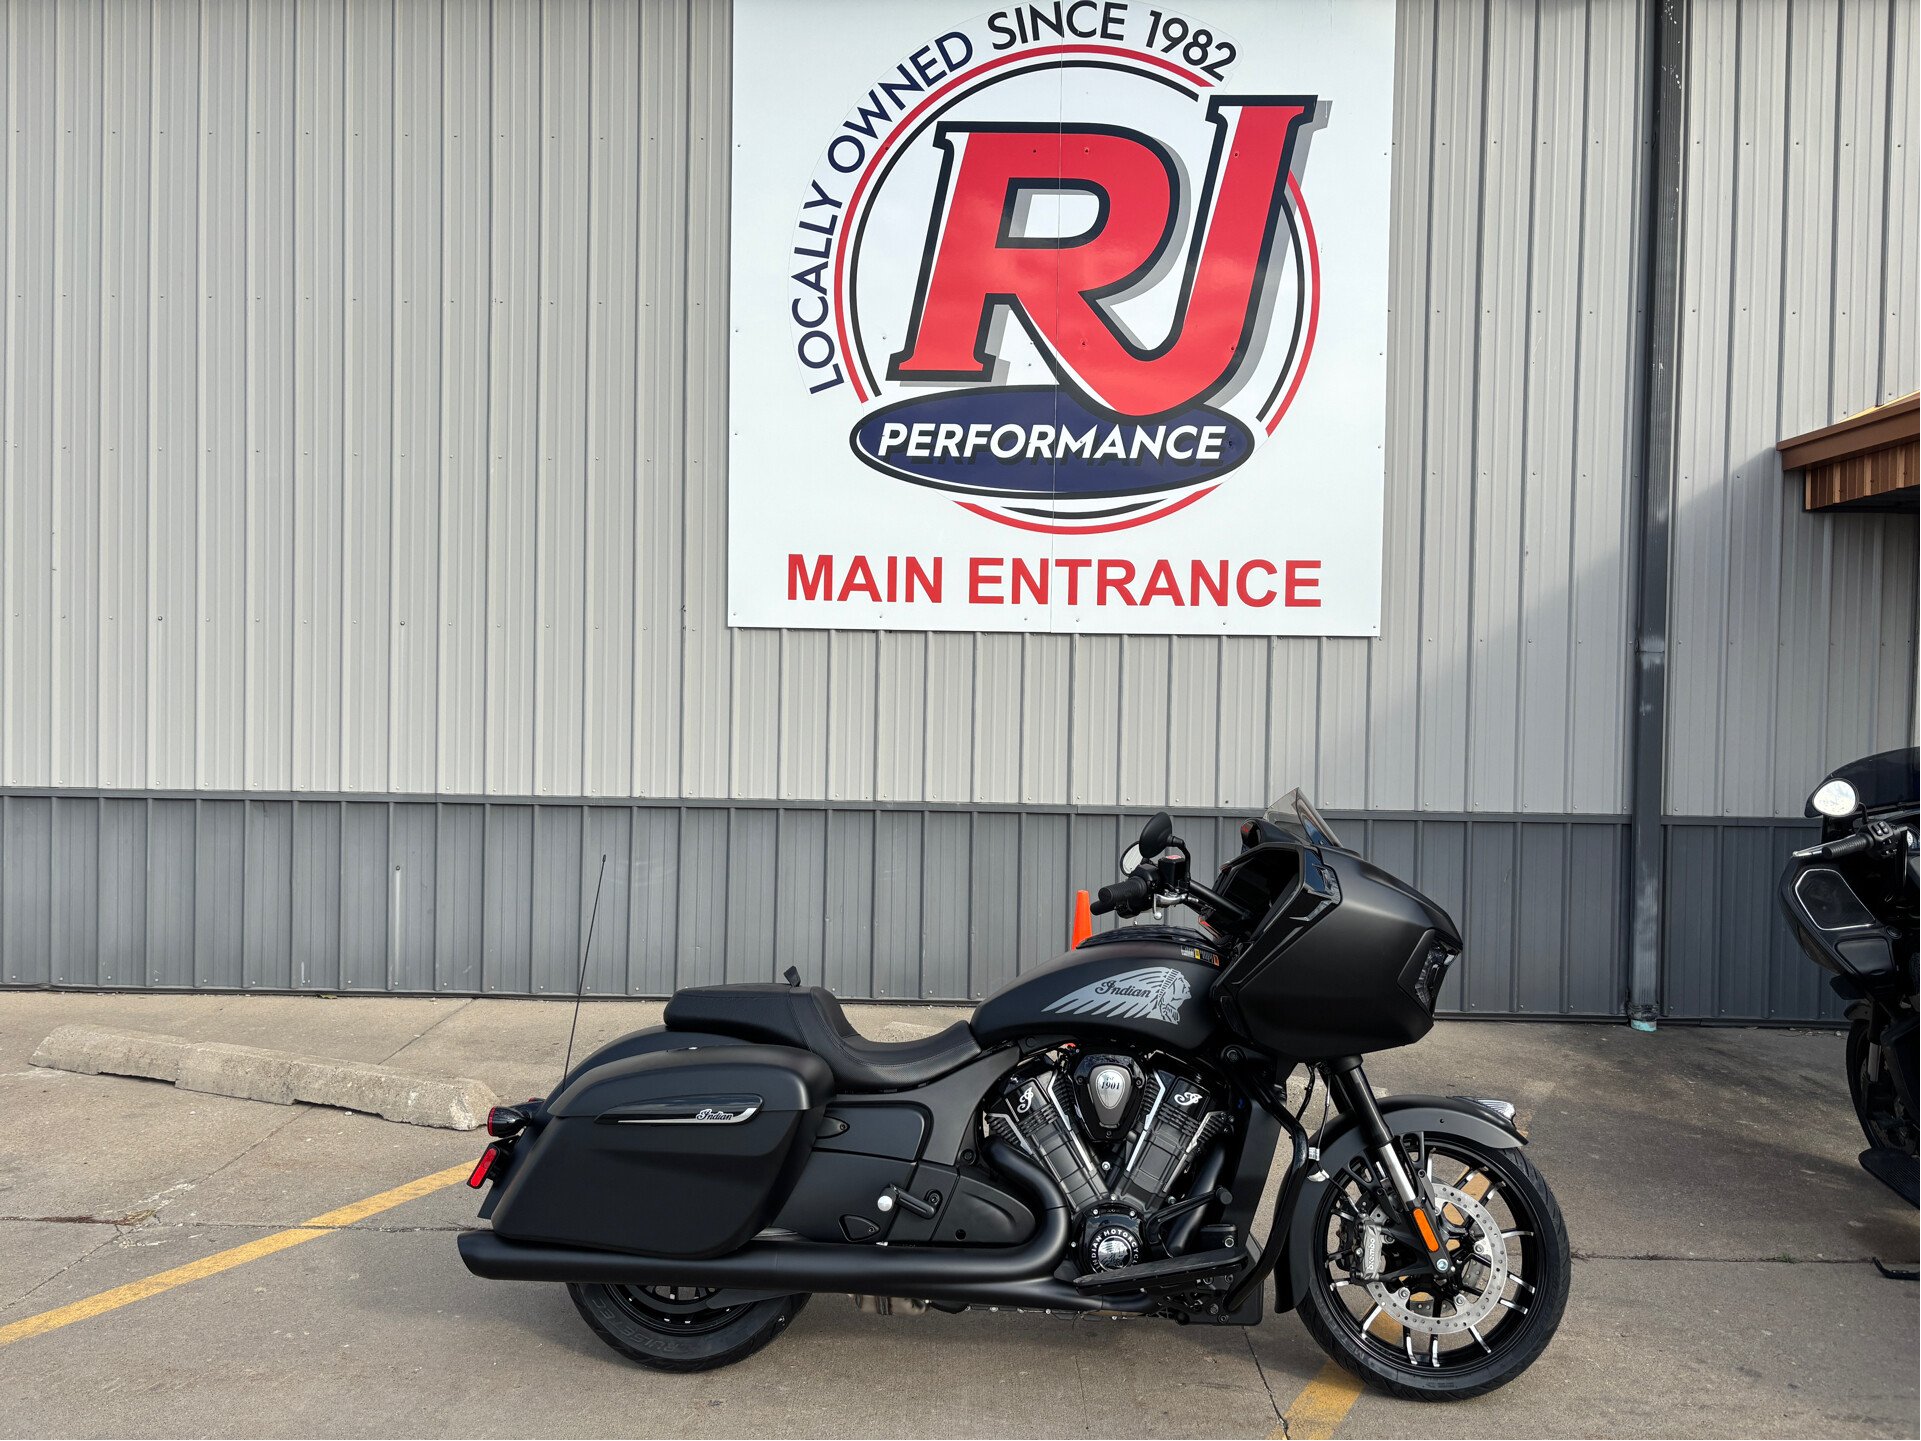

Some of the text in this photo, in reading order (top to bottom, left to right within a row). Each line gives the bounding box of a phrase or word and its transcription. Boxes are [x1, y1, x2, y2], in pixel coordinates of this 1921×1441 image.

[791, 0, 1237, 395] LOCALLY OWNED SINCE 1982
[886, 95, 1319, 426] RJ
[877, 423, 1227, 460] PERFORMANCE
[787, 554, 1322, 608] MAIN ENTRANCE
[1095, 980, 1151, 998] Indian
[1101, 1081, 1120, 1090] 1901
[696, 1109, 733, 1121] Indian
[1091, 1228, 1139, 1270] INDIAN MOTORCYCL
[1366, 1238, 1376, 1270] brembo
